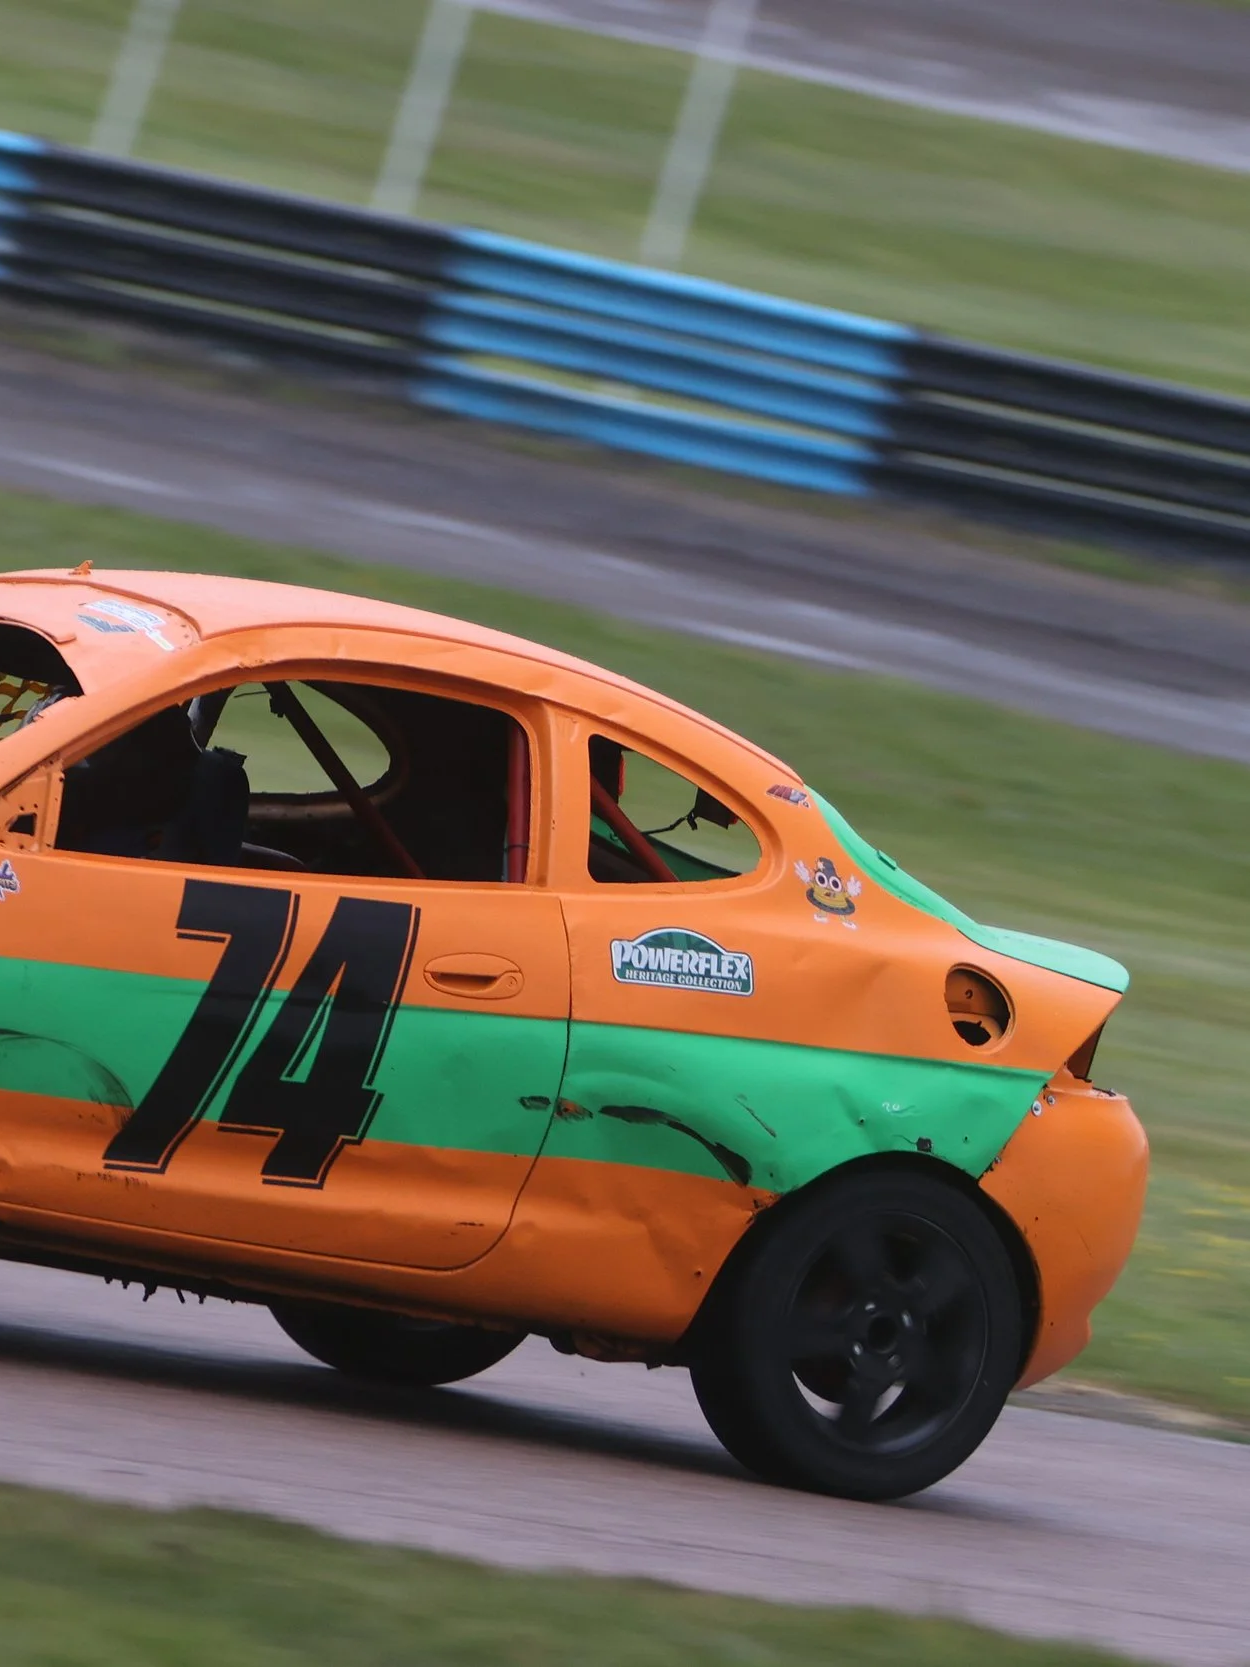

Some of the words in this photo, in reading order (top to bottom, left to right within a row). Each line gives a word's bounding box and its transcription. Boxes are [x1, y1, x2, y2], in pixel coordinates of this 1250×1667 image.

[612, 940, 749, 981] POWERFLEX
[625, 969, 677, 984] HERITAGE
[678, 974, 743, 991] COLLECTION
[103, 878, 421, 1190] 74
